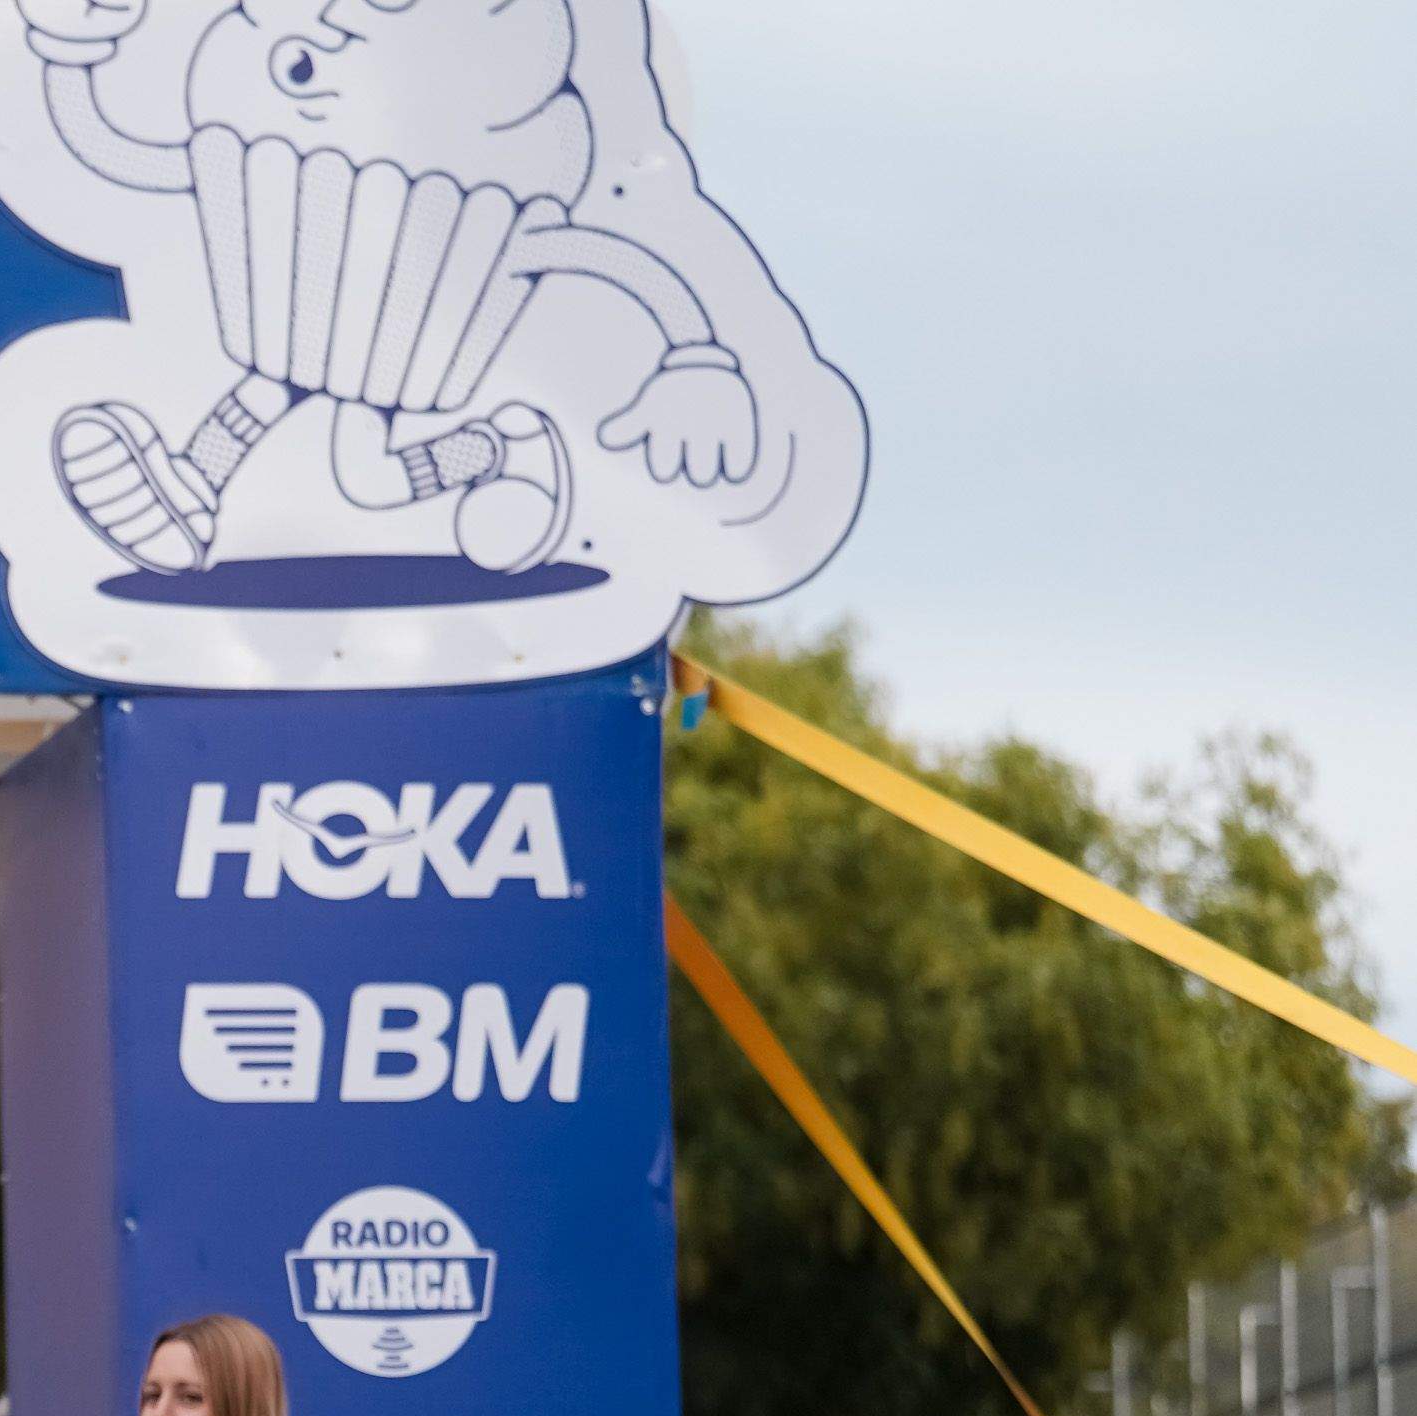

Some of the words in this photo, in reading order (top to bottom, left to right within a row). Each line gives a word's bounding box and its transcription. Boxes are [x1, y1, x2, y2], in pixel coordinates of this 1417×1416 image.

[175, 779, 572, 901] HOKA
[339, 982, 590, 1104] BM
[331, 1219, 451, 1249] RADIO
[313, 1258, 475, 1312] MARCA
